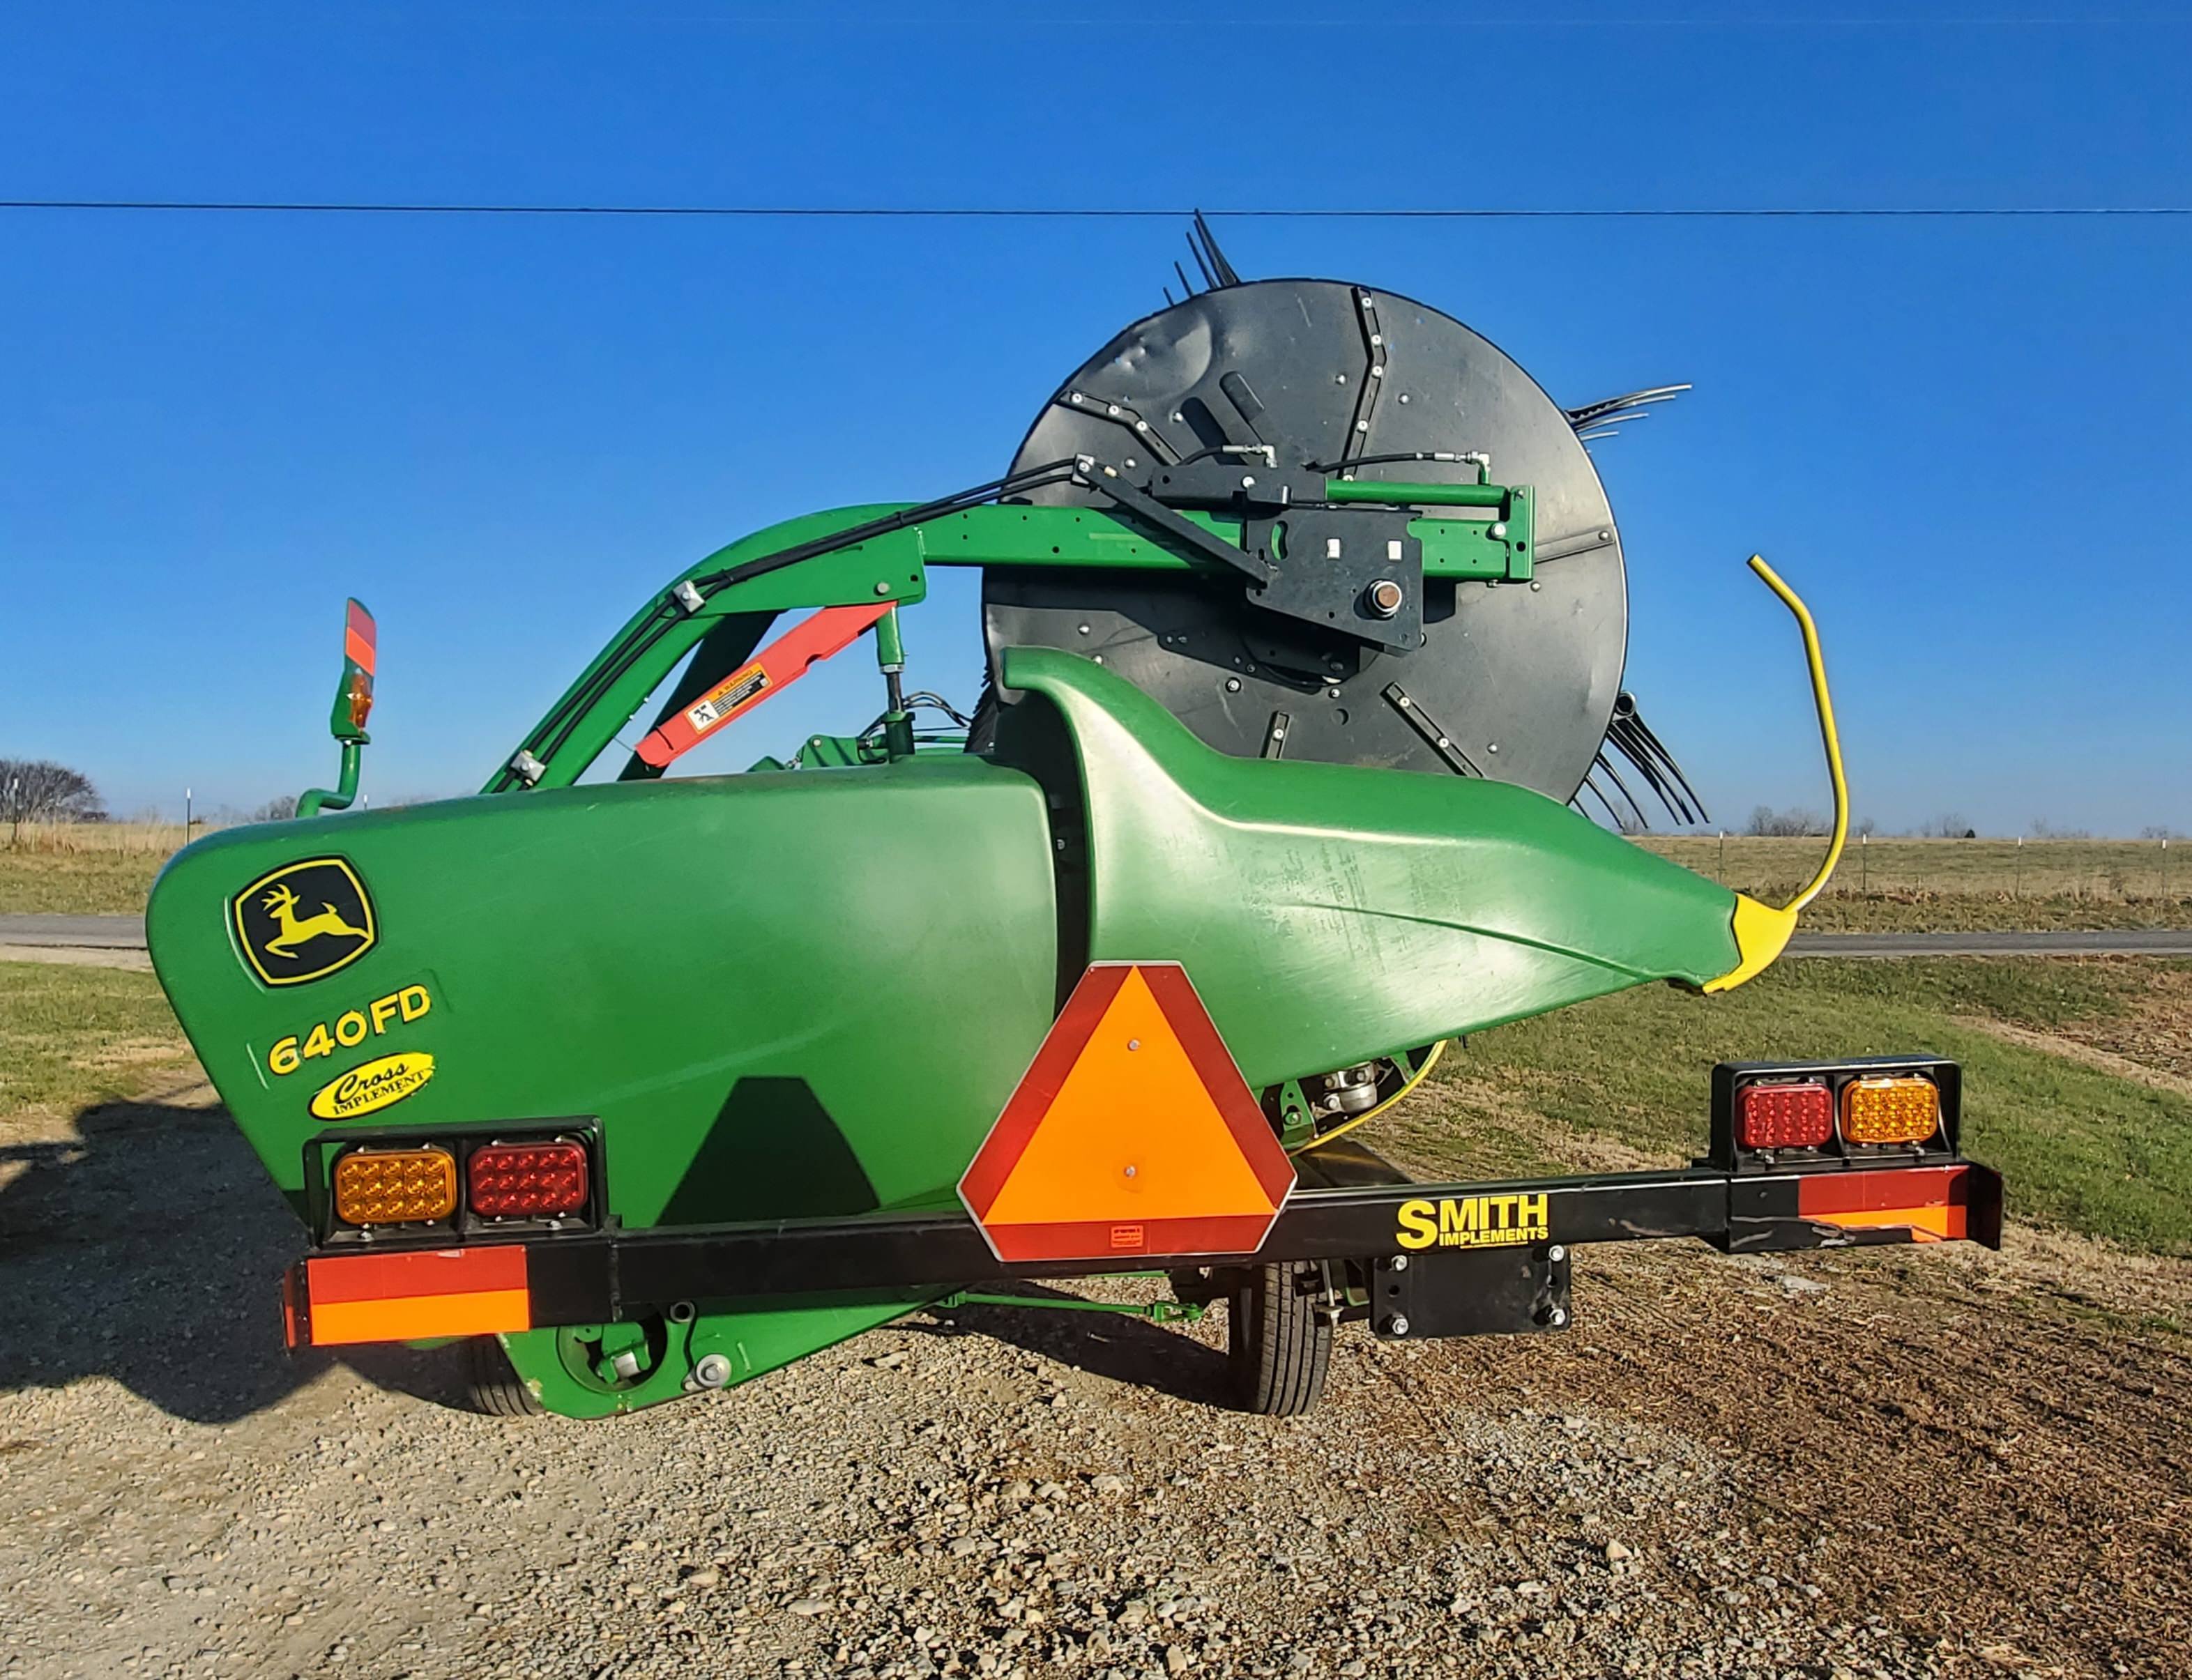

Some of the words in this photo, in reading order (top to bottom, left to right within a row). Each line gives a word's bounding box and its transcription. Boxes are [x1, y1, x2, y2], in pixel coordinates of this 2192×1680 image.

[268, 984, 431, 1074] 640FD
[332, 1070, 424, 1115] IMPLEMENT
[334, 1063, 409, 1104] Cross
[1396, 1193, 1548, 1249] SMITH
[1439, 1226, 1549, 1246] IMPLEMENTS
